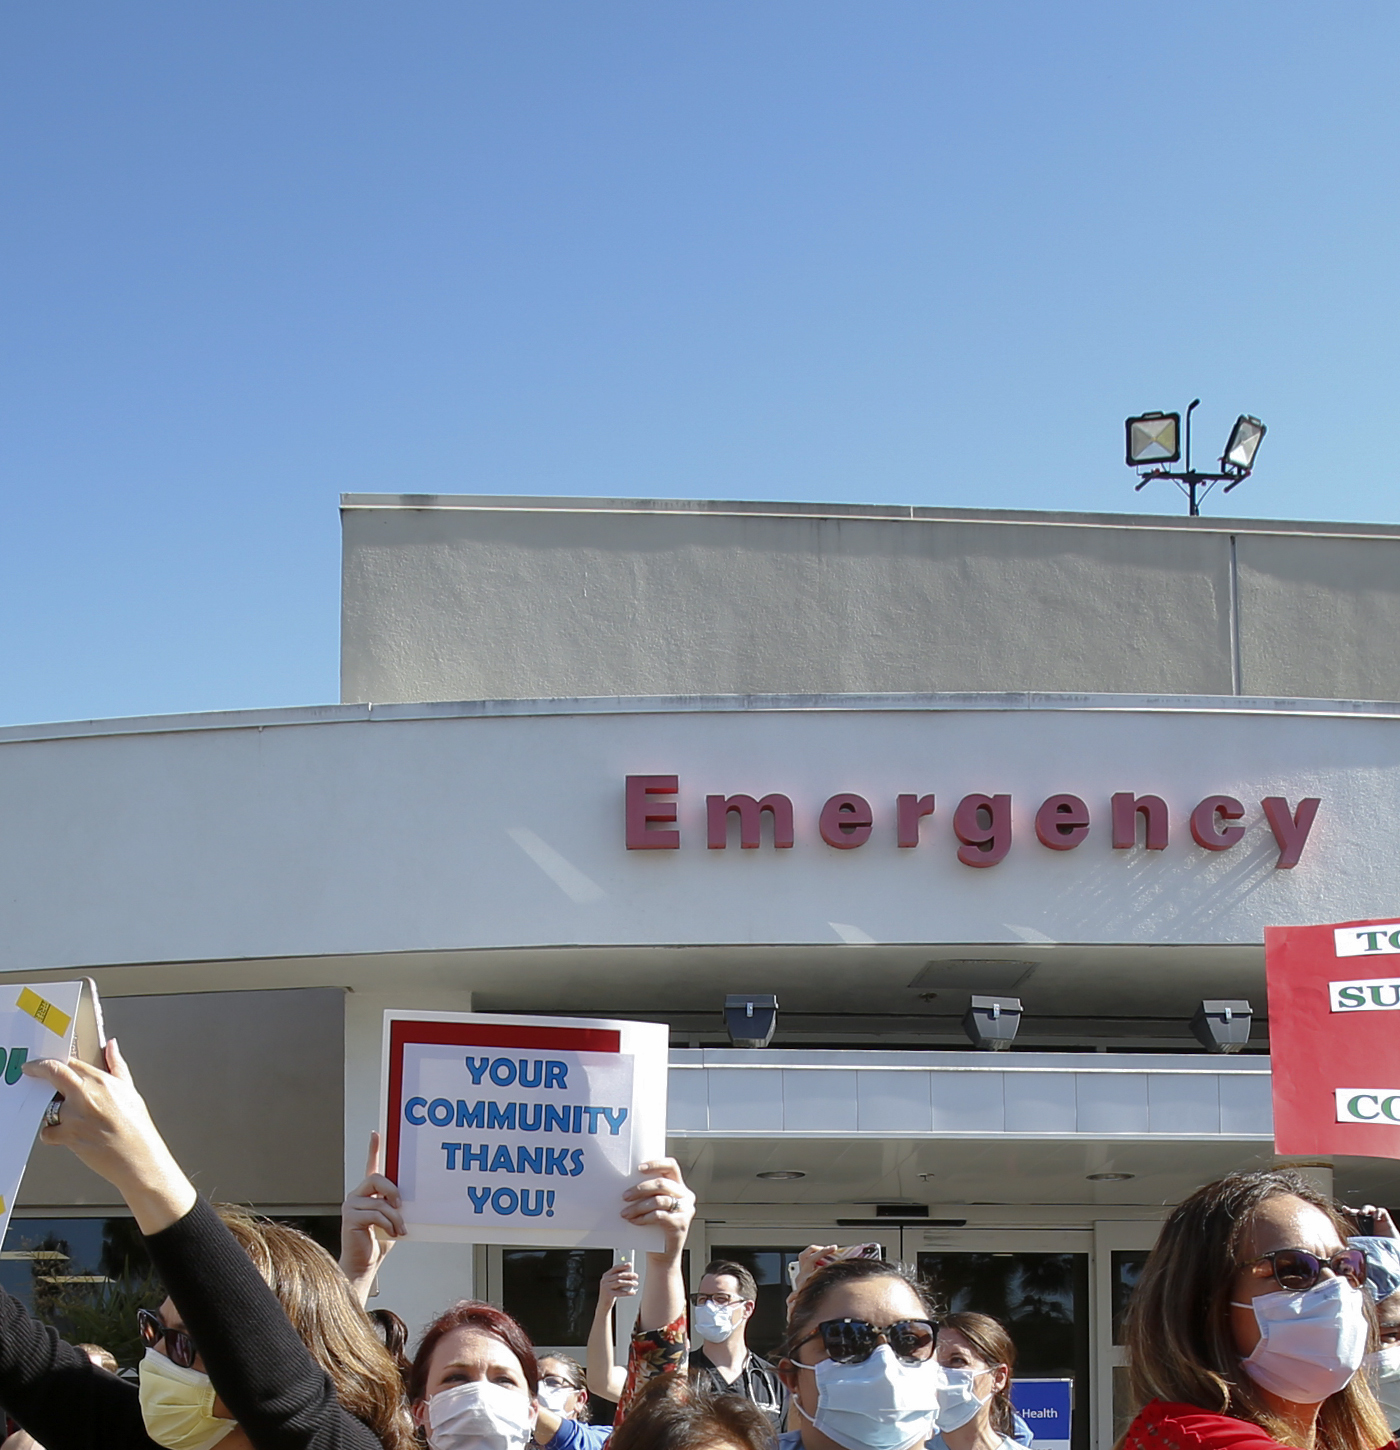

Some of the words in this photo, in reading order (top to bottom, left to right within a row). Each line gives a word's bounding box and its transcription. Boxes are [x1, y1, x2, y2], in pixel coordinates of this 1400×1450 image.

[624, 774, 1322, 869] Emergency
[466, 1056, 568, 1089] YOUR
[404, 1096, 628, 1135] COMMUNITY
[441, 1142, 584, 1177] THANKS
[467, 1186, 555, 1217] YOU!
[1022, 1408, 1058, 1418] Health
